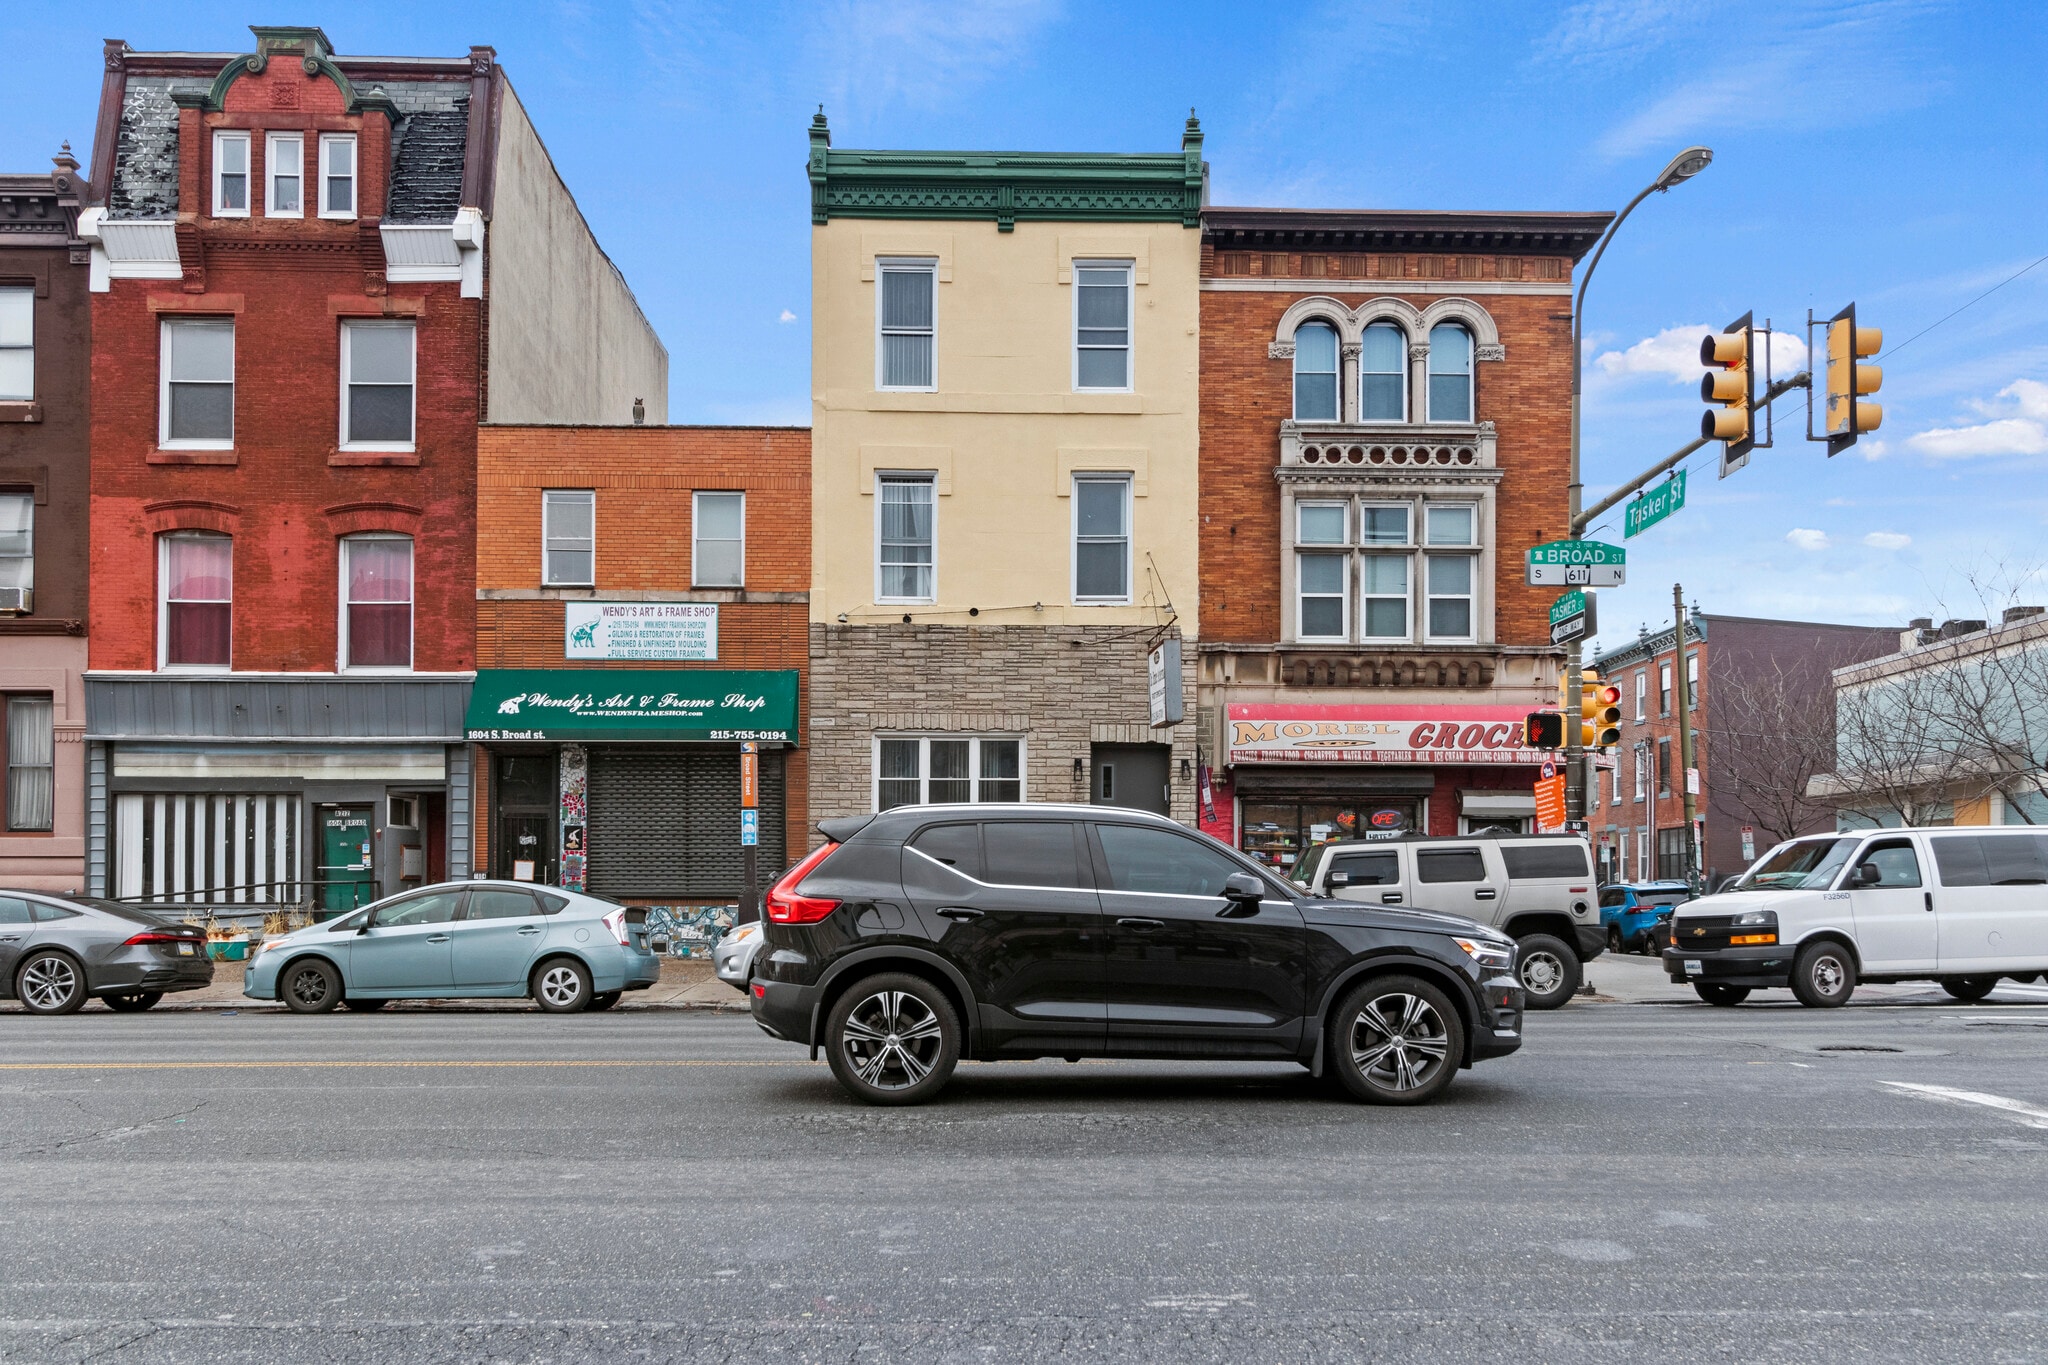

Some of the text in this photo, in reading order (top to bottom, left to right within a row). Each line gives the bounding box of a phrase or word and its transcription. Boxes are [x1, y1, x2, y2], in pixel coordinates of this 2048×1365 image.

[1629, 479, 1682, 528] Tasker St
[1547, 549, 1622, 563] BROAD ST
[1534, 569, 1542, 579] S
[1568, 569, 1586, 581] 611
[1613, 570, 1622, 580] N
[602, 606, 716, 617] WENDY'S ART & FRAME SHOP
[1558, 619, 1581, 637] ONE WAY
[612, 630, 705, 639] GILDING & RESTORATION OF FRAMES
[611, 640, 707, 649] FINISHED & UNFINISHED MOULDING
[611, 649, 706, 658] FULL SERVICE CUSTOM FRAMING
[527, 692, 766, 713] Wendy's Art & Frame Shop
[468, 730, 546, 740] 1604 S. Broad st.
[710, 730, 788, 741] 215-755-0194
[1233, 722, 1526, 750] MOREL GROCE
[1261, 750, 1284, 762] FROZEN
[1285, 750, 1300, 761] FOOD
[1304, 751, 1339, 761] CIGARETTES
[1342, 751, 1361, 761] WATER
[1362, 751, 1373, 761] ICE
[1377, 751, 1412, 762] VEGETABLES
[1415, 751, 1430, 762] MILK
[1434, 751, 1444, 762] ICE
[1444, 751, 1464, 762] CREAM
[1468, 751, 1493, 762] CALLING
[1493, 751, 1512, 762] CARDS
[1516, 751, 1531, 762] FOOD
[1572, 822, 1581, 830] NO
